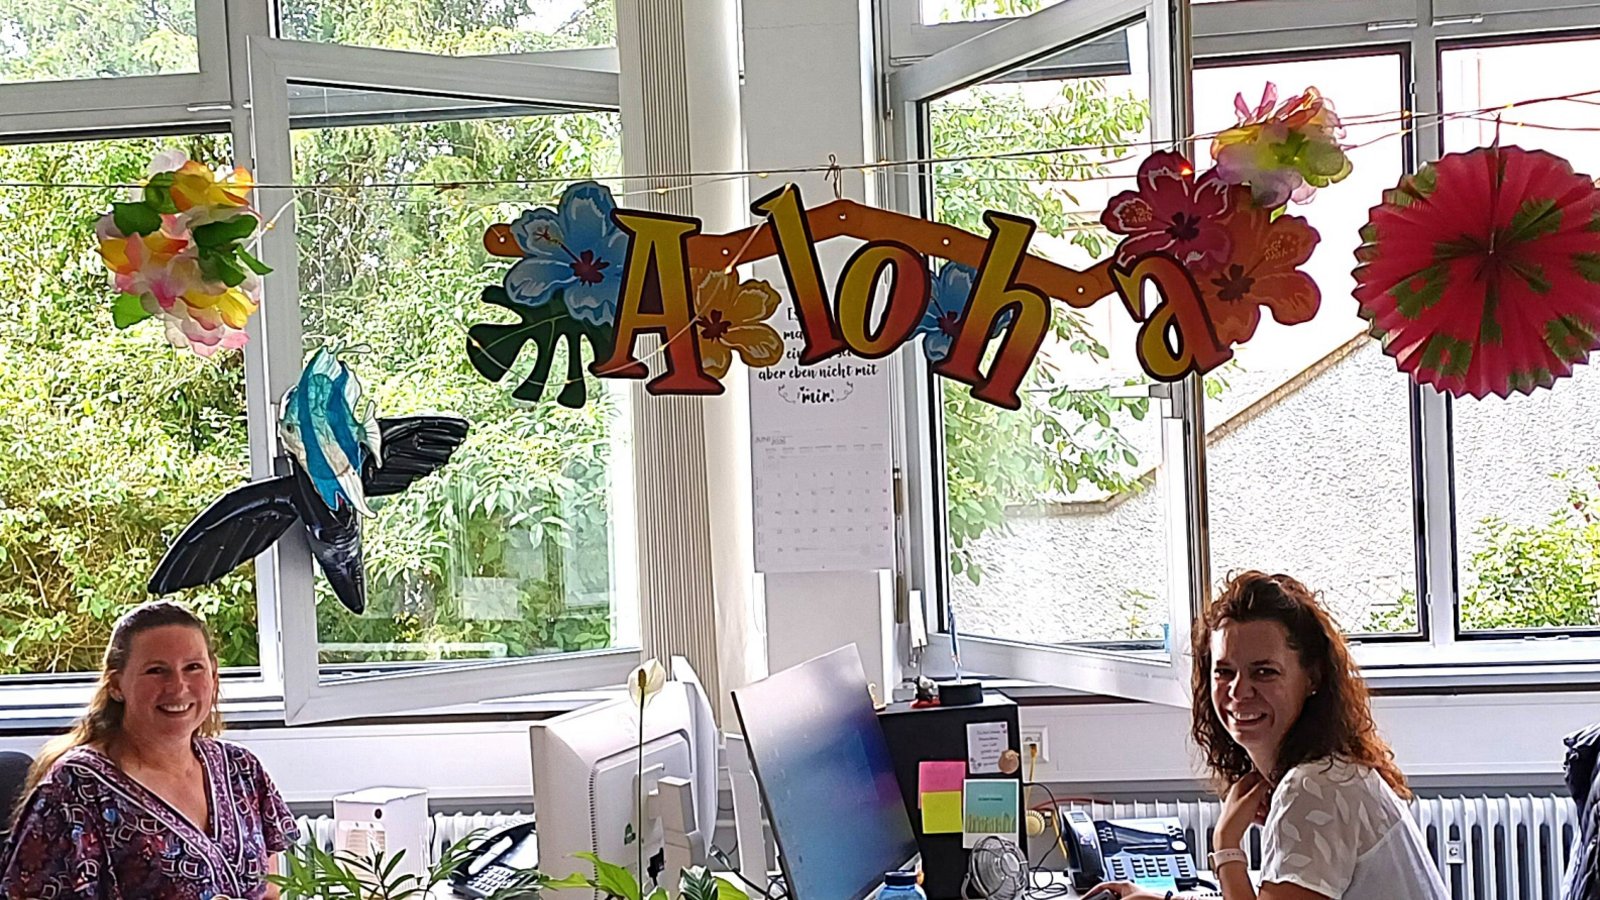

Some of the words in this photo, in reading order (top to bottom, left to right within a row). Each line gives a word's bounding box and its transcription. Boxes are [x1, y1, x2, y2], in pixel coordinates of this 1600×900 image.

[593, 183, 1232, 409] Aloha
[758, 366, 786, 381] aber
[789, 365, 816, 379] eben
[819, 363, 853, 379] nicht
[855, 364, 879, 377] mit
